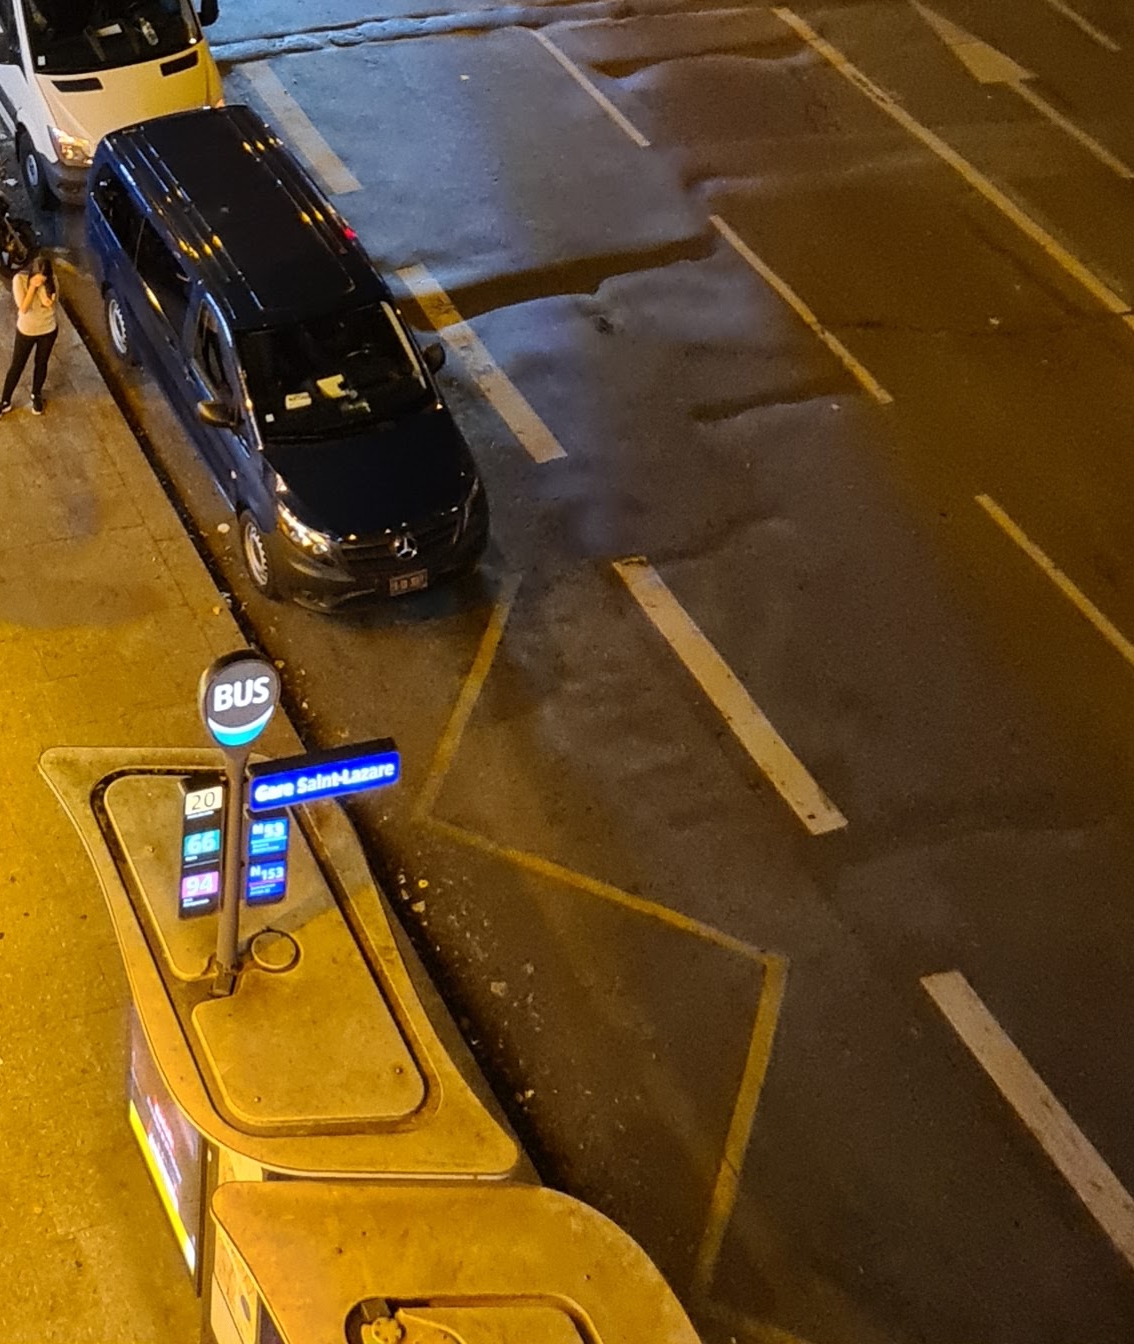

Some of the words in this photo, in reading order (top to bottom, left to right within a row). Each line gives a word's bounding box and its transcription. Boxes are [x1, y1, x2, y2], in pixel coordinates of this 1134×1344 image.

[214, 676, 270, 712] BUS
[255, 782, 294, 802] Gare
[296, 763, 395, 794] Saint-Lazare
[191, 791, 216, 811] 20
[187, 831, 216, 854] 66
[185, 874, 213, 897] 94
